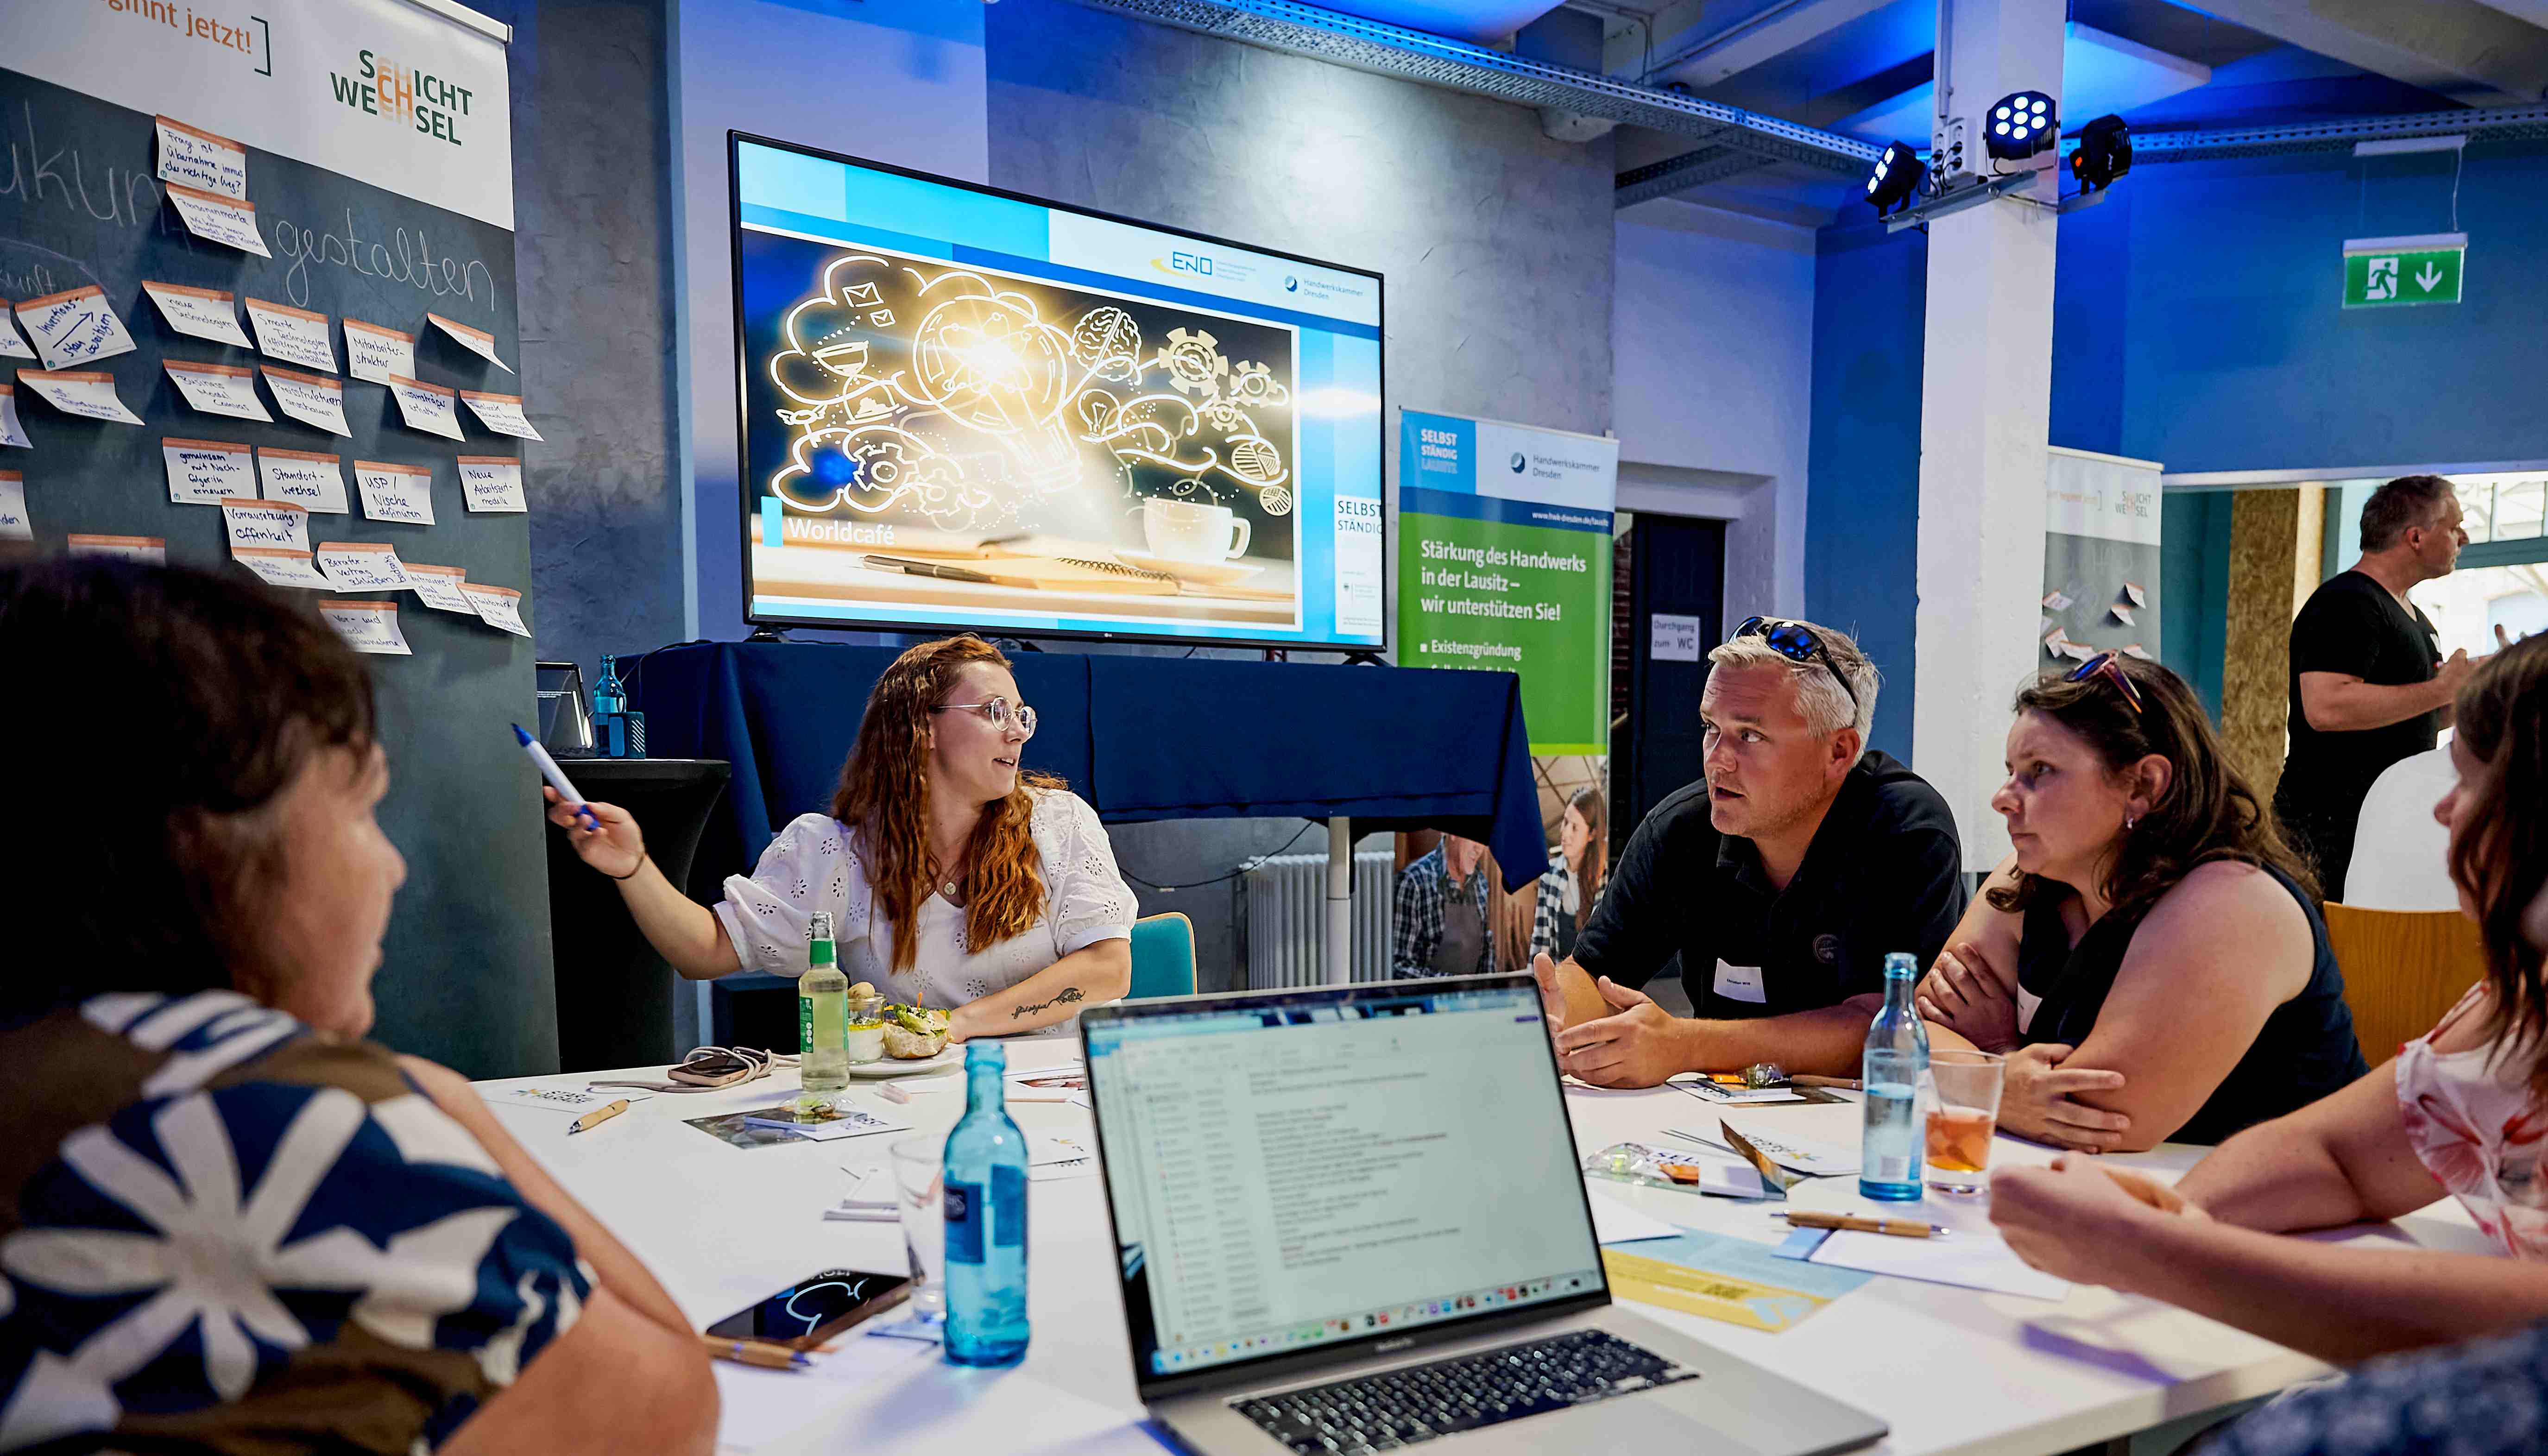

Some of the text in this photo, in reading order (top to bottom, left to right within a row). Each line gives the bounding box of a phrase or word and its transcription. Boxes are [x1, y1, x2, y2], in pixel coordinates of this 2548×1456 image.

[186, 8, 252, 54] jetzt!
[275, 208, 495, 307] gestalten
[1173, 251, 1212, 275] ENO
[1420, 428, 1458, 447] SELBST
[180, 452, 226, 464] gemeinsam
[1420, 444, 1458, 460] STÄNDIG
[191, 462, 208, 471] mit
[1533, 454, 1601, 472] Handwerkskammer
[365, 476, 388, 489] USP
[468, 469, 494, 479] Neue
[1533, 468, 1562, 479] Dresden
[372, 493, 410, 507] Nische
[235, 527, 293, 543] Offenheit
[787, 517, 895, 545] Worldcafé
[1420, 540, 1587, 573] Stärkung des Handwerks
[1421, 567, 1435, 586] in
[1437, 567, 1461, 588] der
[1464, 571, 1508, 592] Lausitz
[1420, 595, 1561, 621] wir unterstützen Sie!
[1431, 639, 1522, 661] Existenzgründung
[1677, 637, 1694, 649] WC
